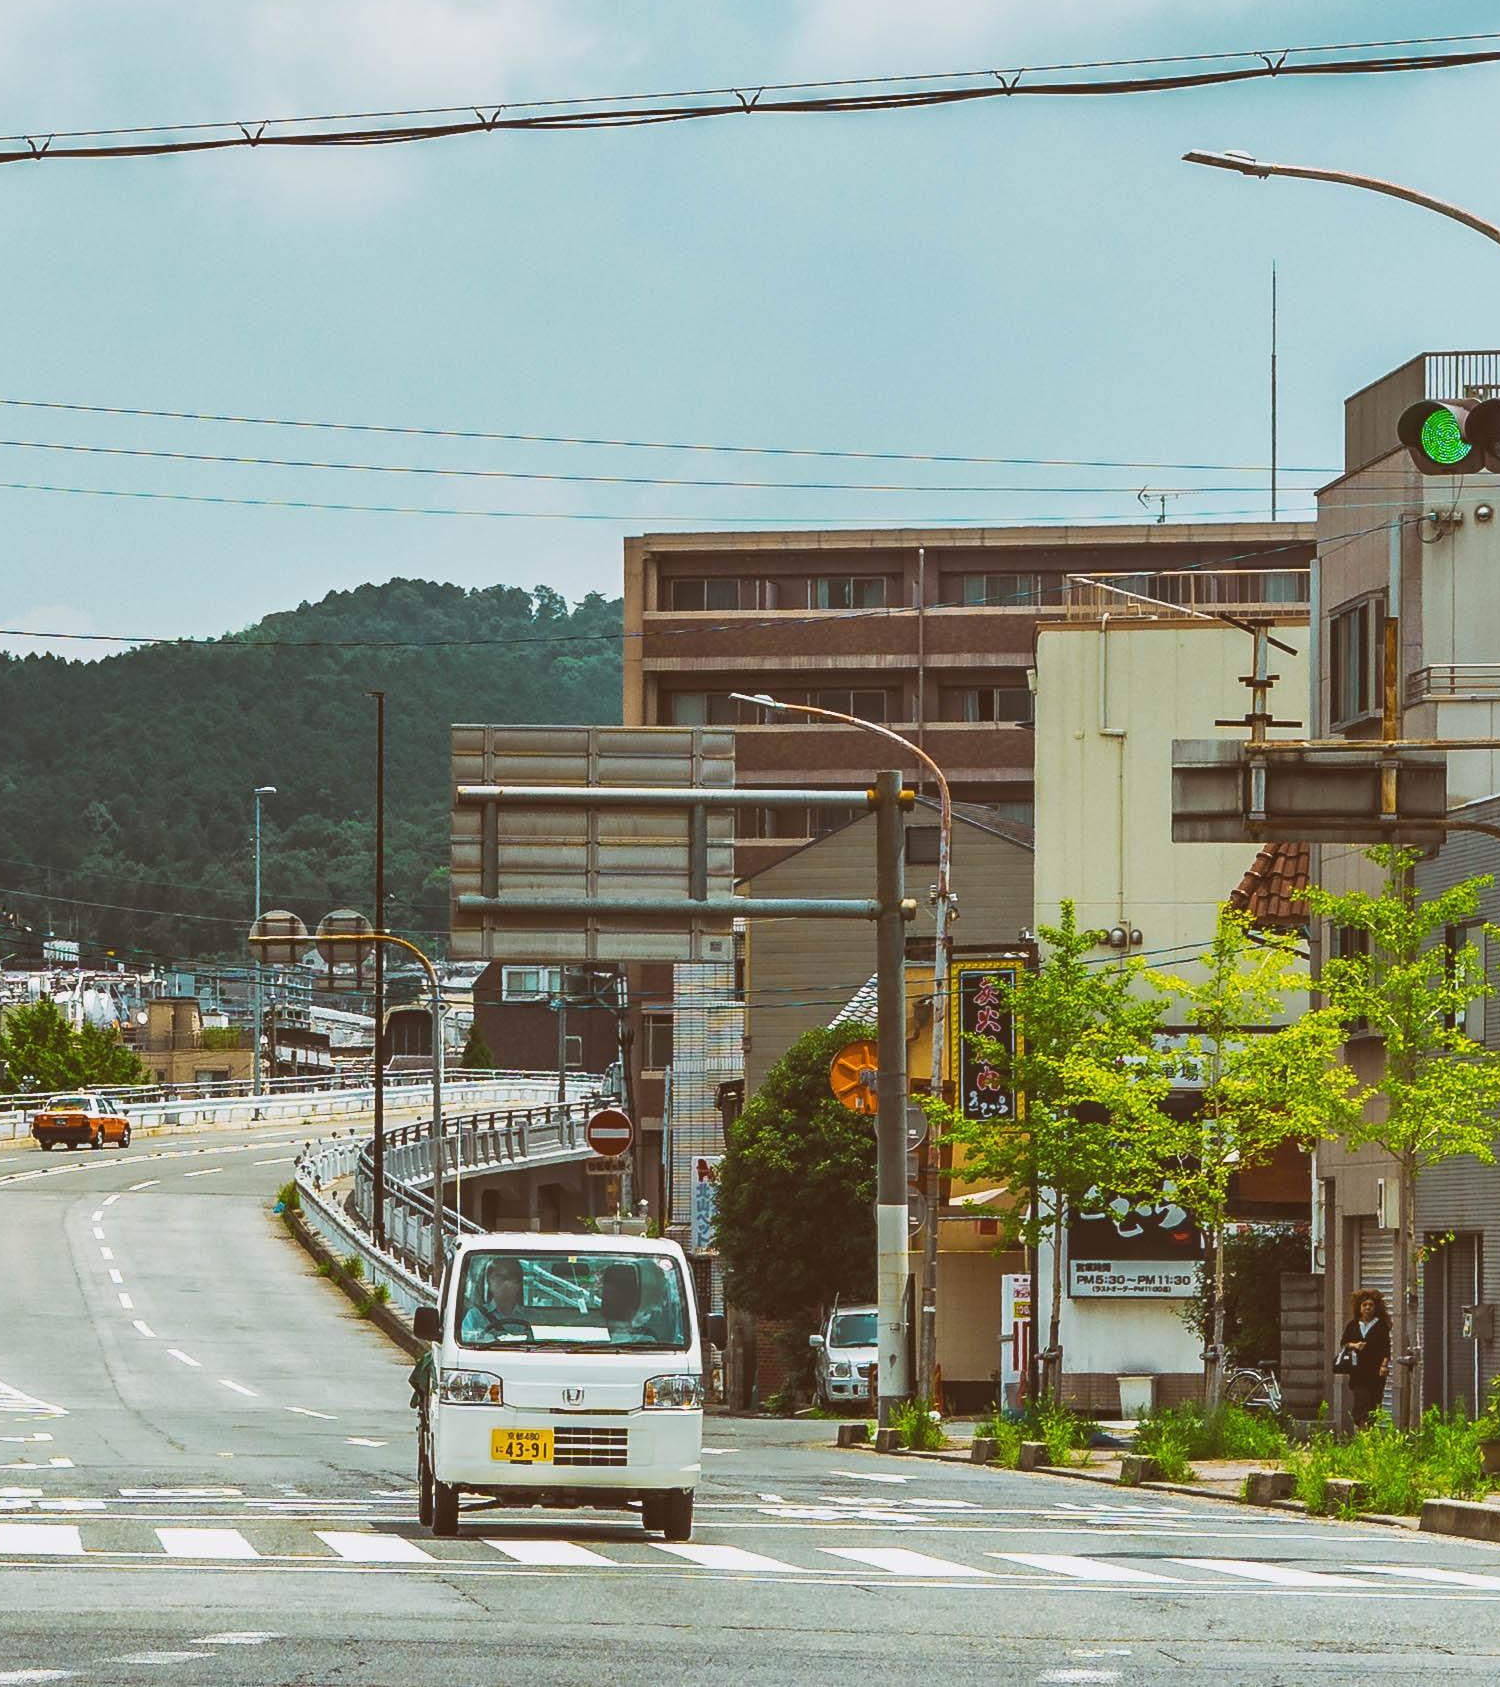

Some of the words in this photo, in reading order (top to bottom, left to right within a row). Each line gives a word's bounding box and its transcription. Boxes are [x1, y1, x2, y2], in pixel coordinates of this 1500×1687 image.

[973, 976, 1001, 1091] 炭火肉
[505, 1442, 547, 1459] 43-91
